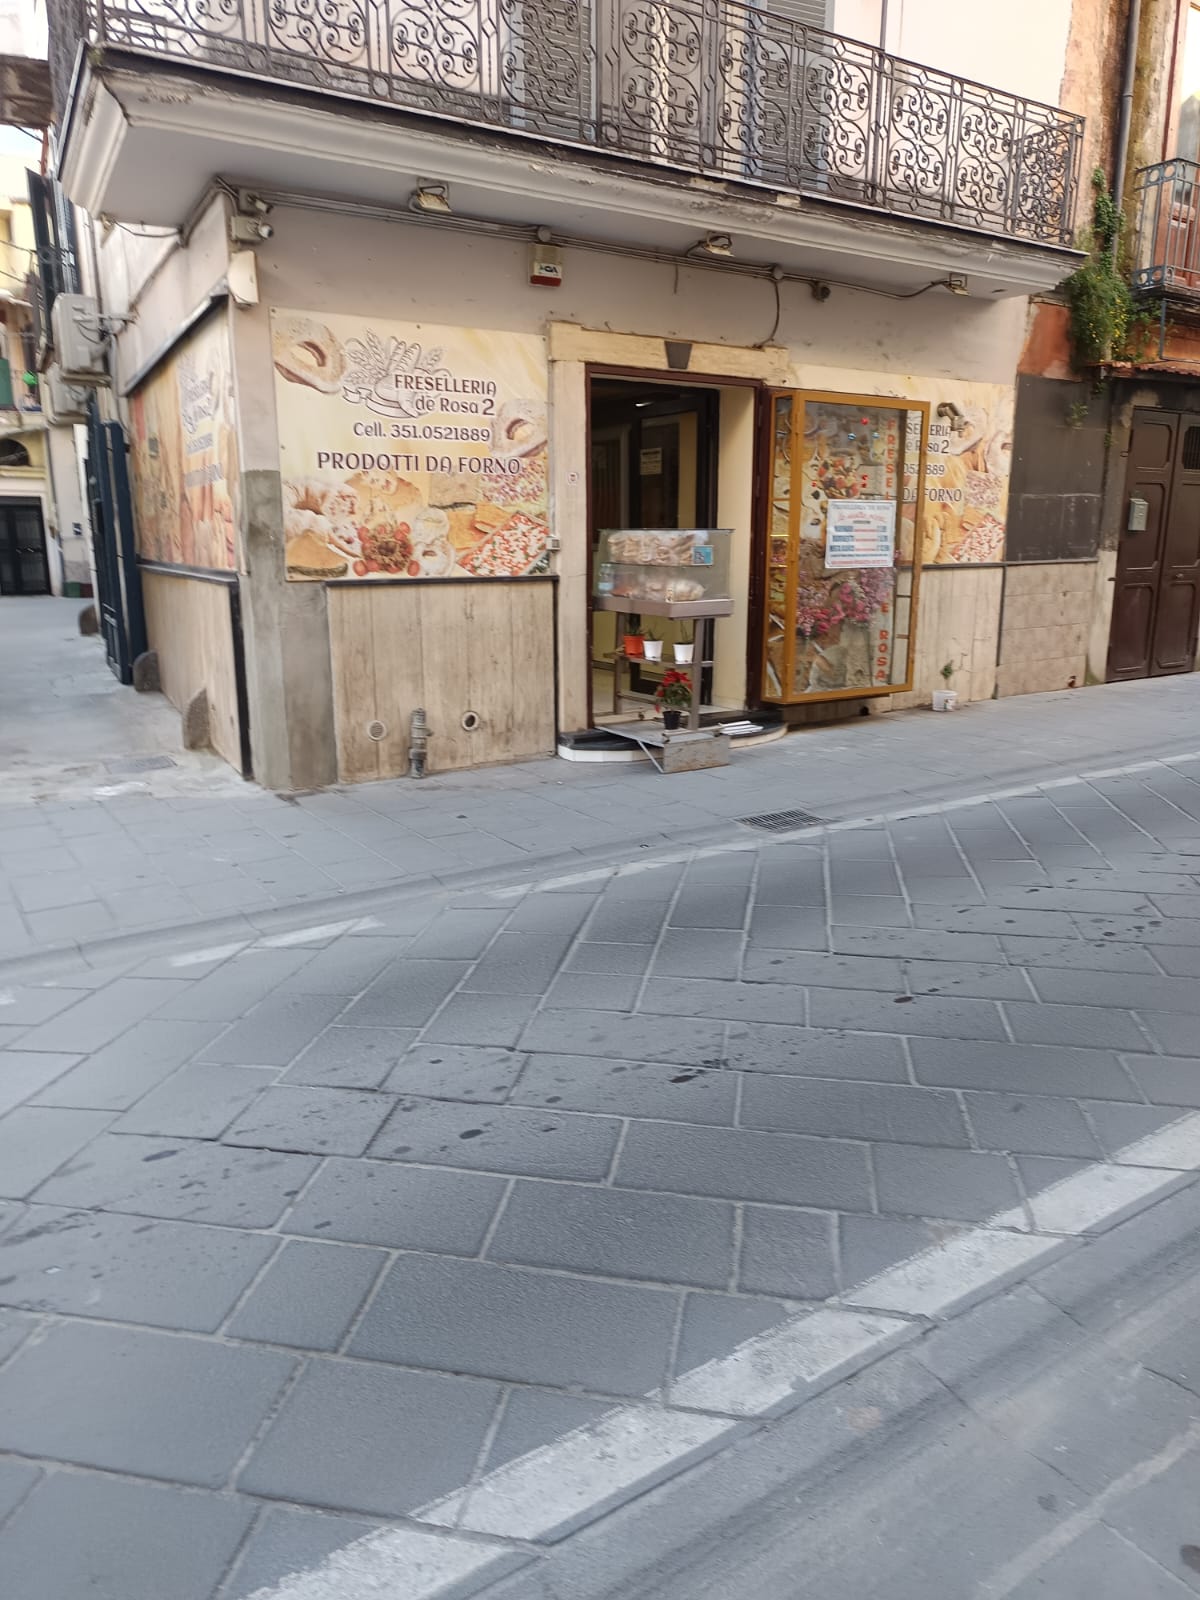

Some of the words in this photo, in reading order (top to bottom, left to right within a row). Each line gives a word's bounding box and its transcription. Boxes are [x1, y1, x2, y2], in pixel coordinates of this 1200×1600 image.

[394, 374, 497, 397] FRESELLERIA
[415, 395, 435, 411] de
[440, 397, 479, 414] Rosa
[482, 398, 495, 416] 2
[353, 421, 386, 438] Cell.
[391, 424, 491, 442] 351.0521889
[906, 422, 952, 438] SEERIA
[941, 439, 950, 454] 2
[317, 452, 419, 472] PRODOTTI
[426, 456, 452, 474] DA
[459, 457, 520, 474] FORNO
[885, 419, 896, 500] FRESEL
[875, 630, 889, 680] ROSA
